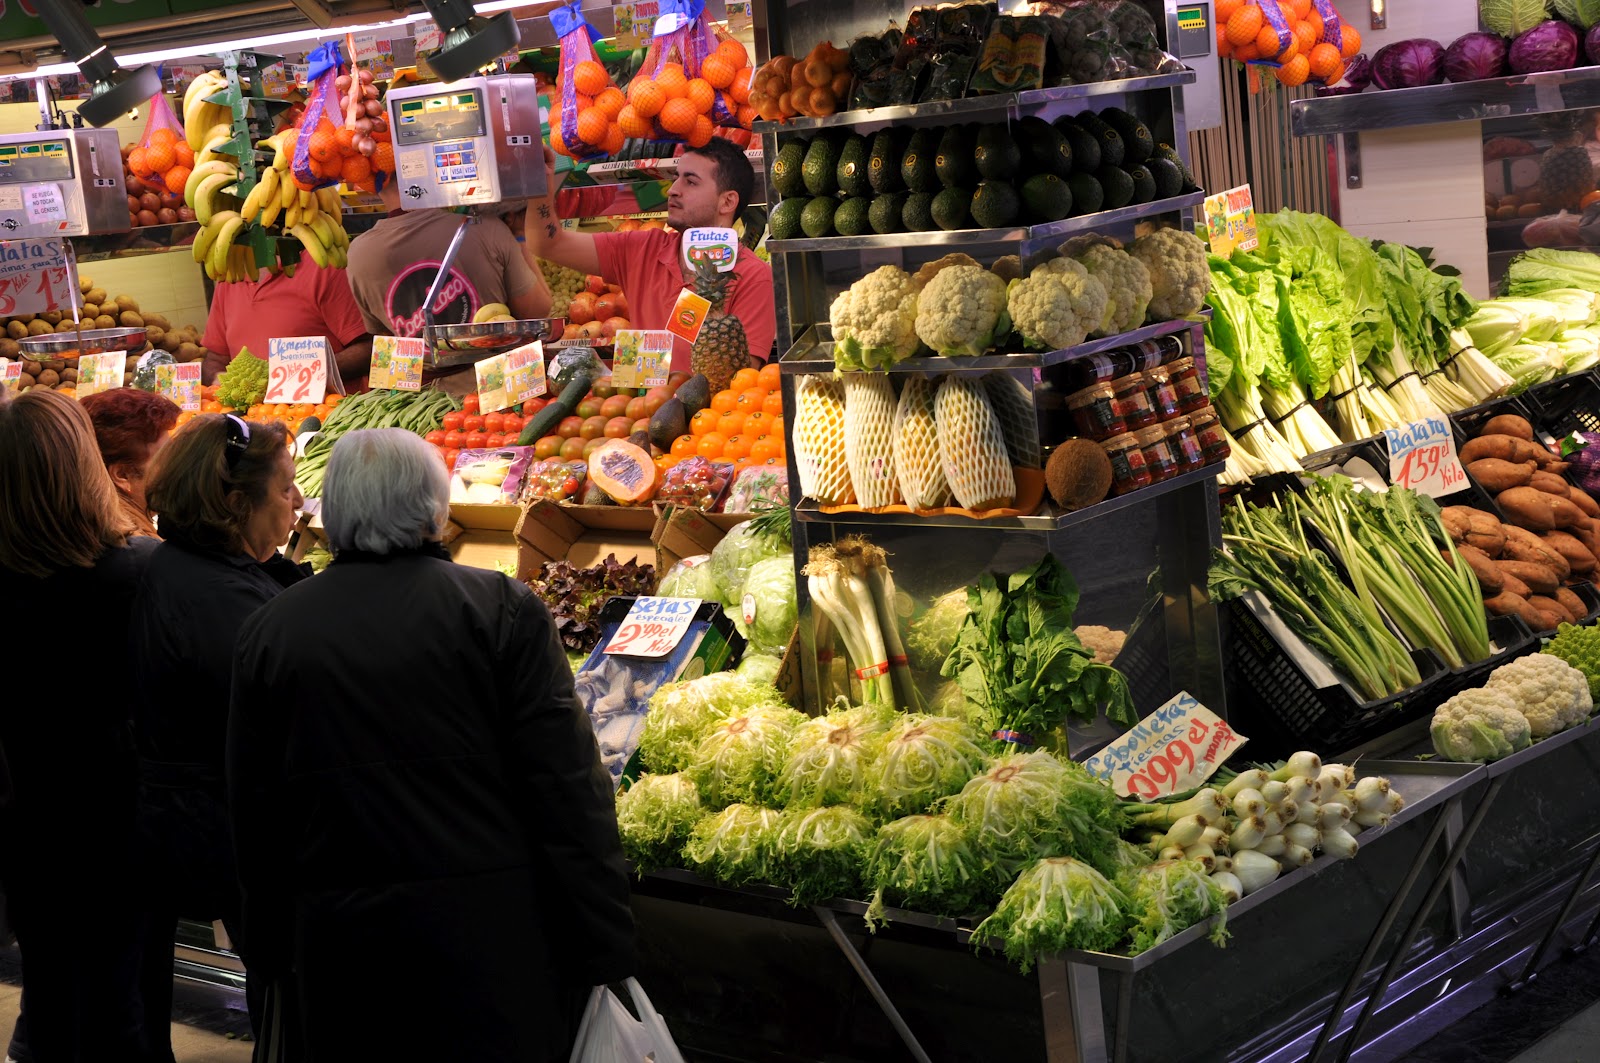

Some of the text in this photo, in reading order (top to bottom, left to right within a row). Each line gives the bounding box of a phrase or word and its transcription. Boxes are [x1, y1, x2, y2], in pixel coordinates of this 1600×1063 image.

[635, 2, 659, 18] FRUTAS
[451, 165, 463, 175] VISA
[465, 164, 476, 173] VISA
[690, 229, 730, 242] Frutas
[1239, 239, 1257, 250] KILO
[396, 339, 423, 357] FRUTAS
[643, 332, 674, 351] FRUTAS
[176, 364, 201, 381] FRUTAS
[519, 386, 544, 400] KILO
[1386, 417, 1451, 456] Batata
[1440, 461, 1465, 490] Kilo
[628, 597, 696, 615] Setas
[643, 638, 674, 653] Kilo
[1085, 693, 1200, 781] Cebolletas
[1116, 723, 1186, 774] tiernas
